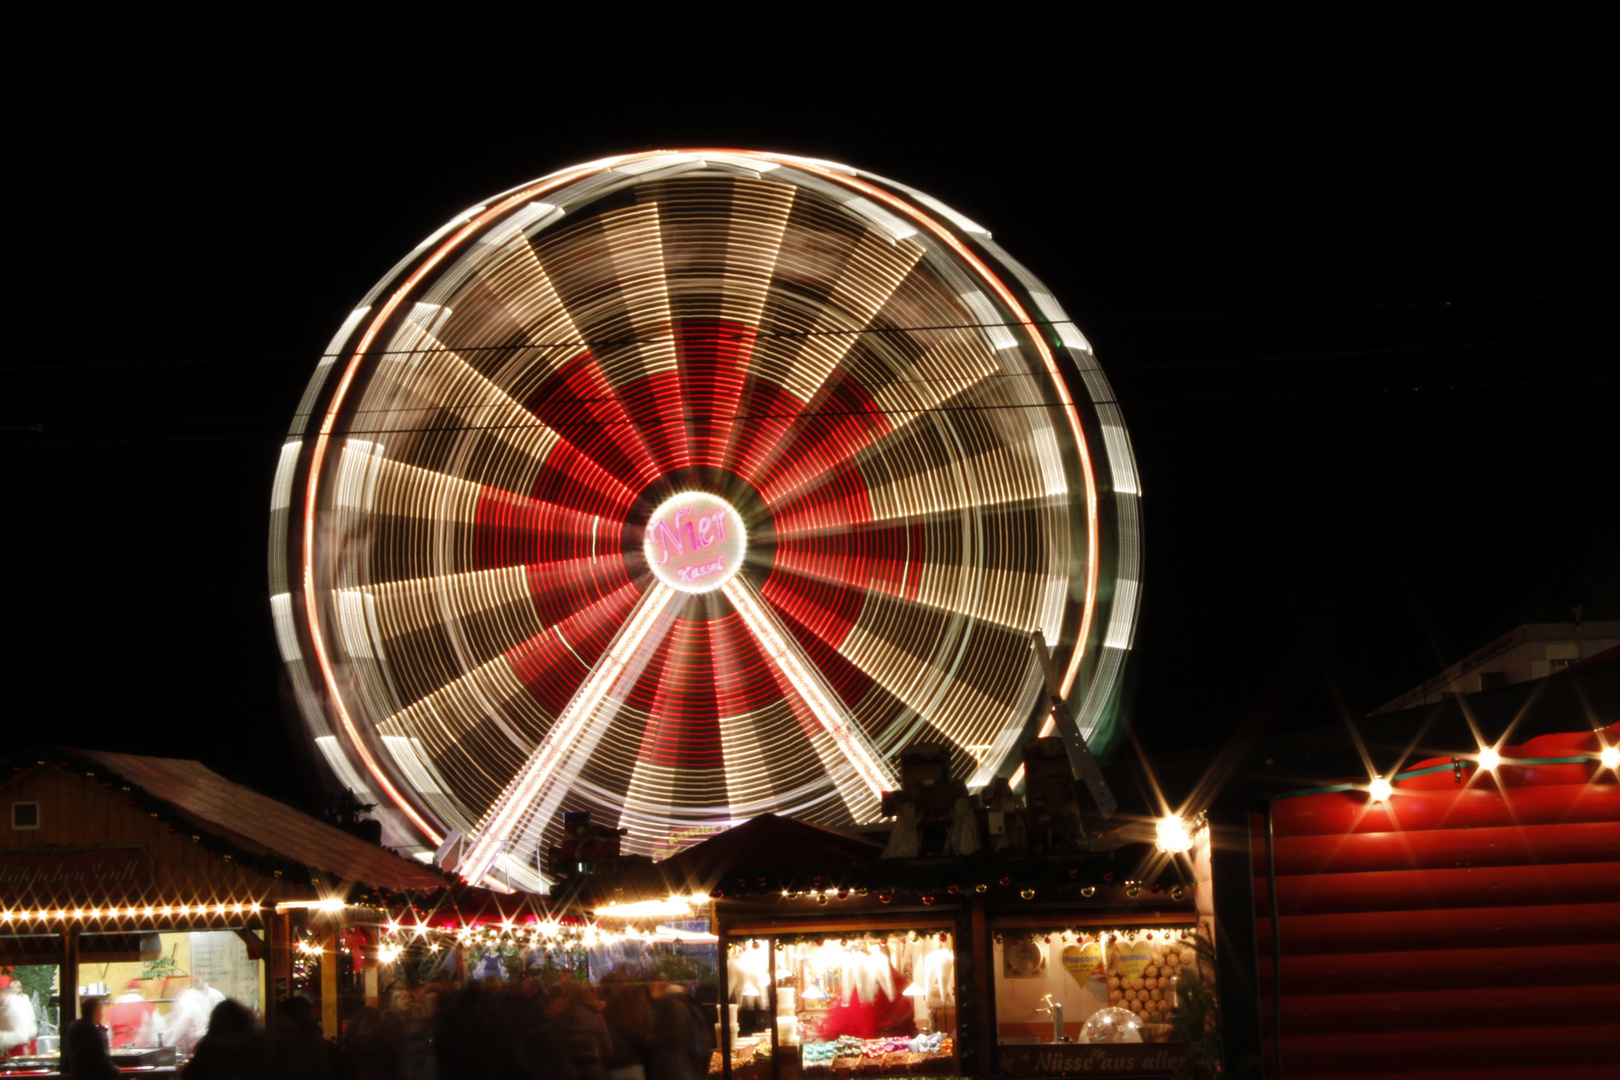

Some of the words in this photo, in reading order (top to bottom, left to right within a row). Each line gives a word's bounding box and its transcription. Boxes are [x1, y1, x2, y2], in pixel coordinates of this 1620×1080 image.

[677, 554, 725, 582] Kassel
[93, 860, 140, 881] Grill
[1034, 1052, 1094, 1072] Nüsse
[1100, 1056, 1136, 1071] aus
